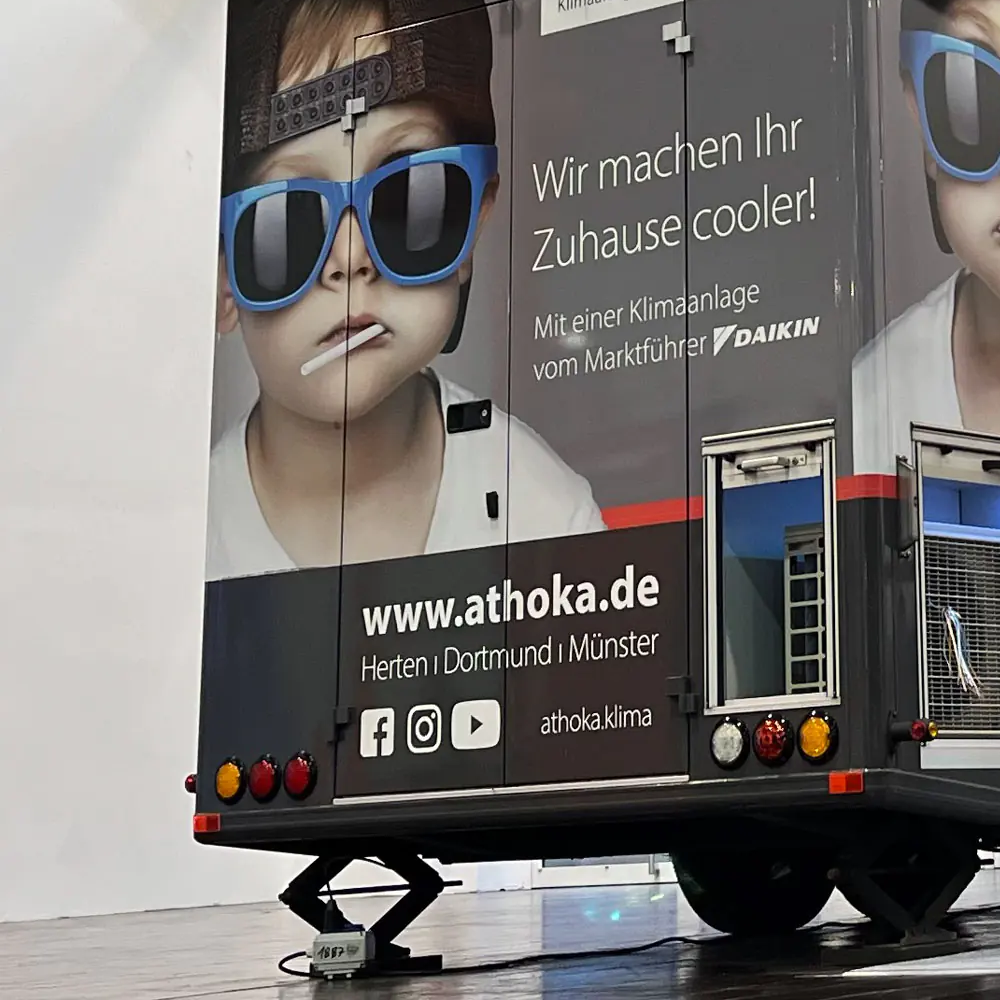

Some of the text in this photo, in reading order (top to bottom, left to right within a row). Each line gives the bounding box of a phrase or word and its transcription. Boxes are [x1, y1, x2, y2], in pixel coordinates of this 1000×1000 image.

[532, 112, 803, 203] Wir machen Ihr
[532, 176, 817, 272] Zuhause cooler!
[533, 283, 760, 340] Mit einer Klimaanlage
[533, 316, 820, 382] vom Marktführer DAIKIN
[362, 564, 660, 637] www.athoka.de
[361, 653, 428, 682] Herten
[444, 635, 552, 675] Dortmund
[568, 630, 660, 663] Münster
[540, 704, 653, 735] athoka.klima
